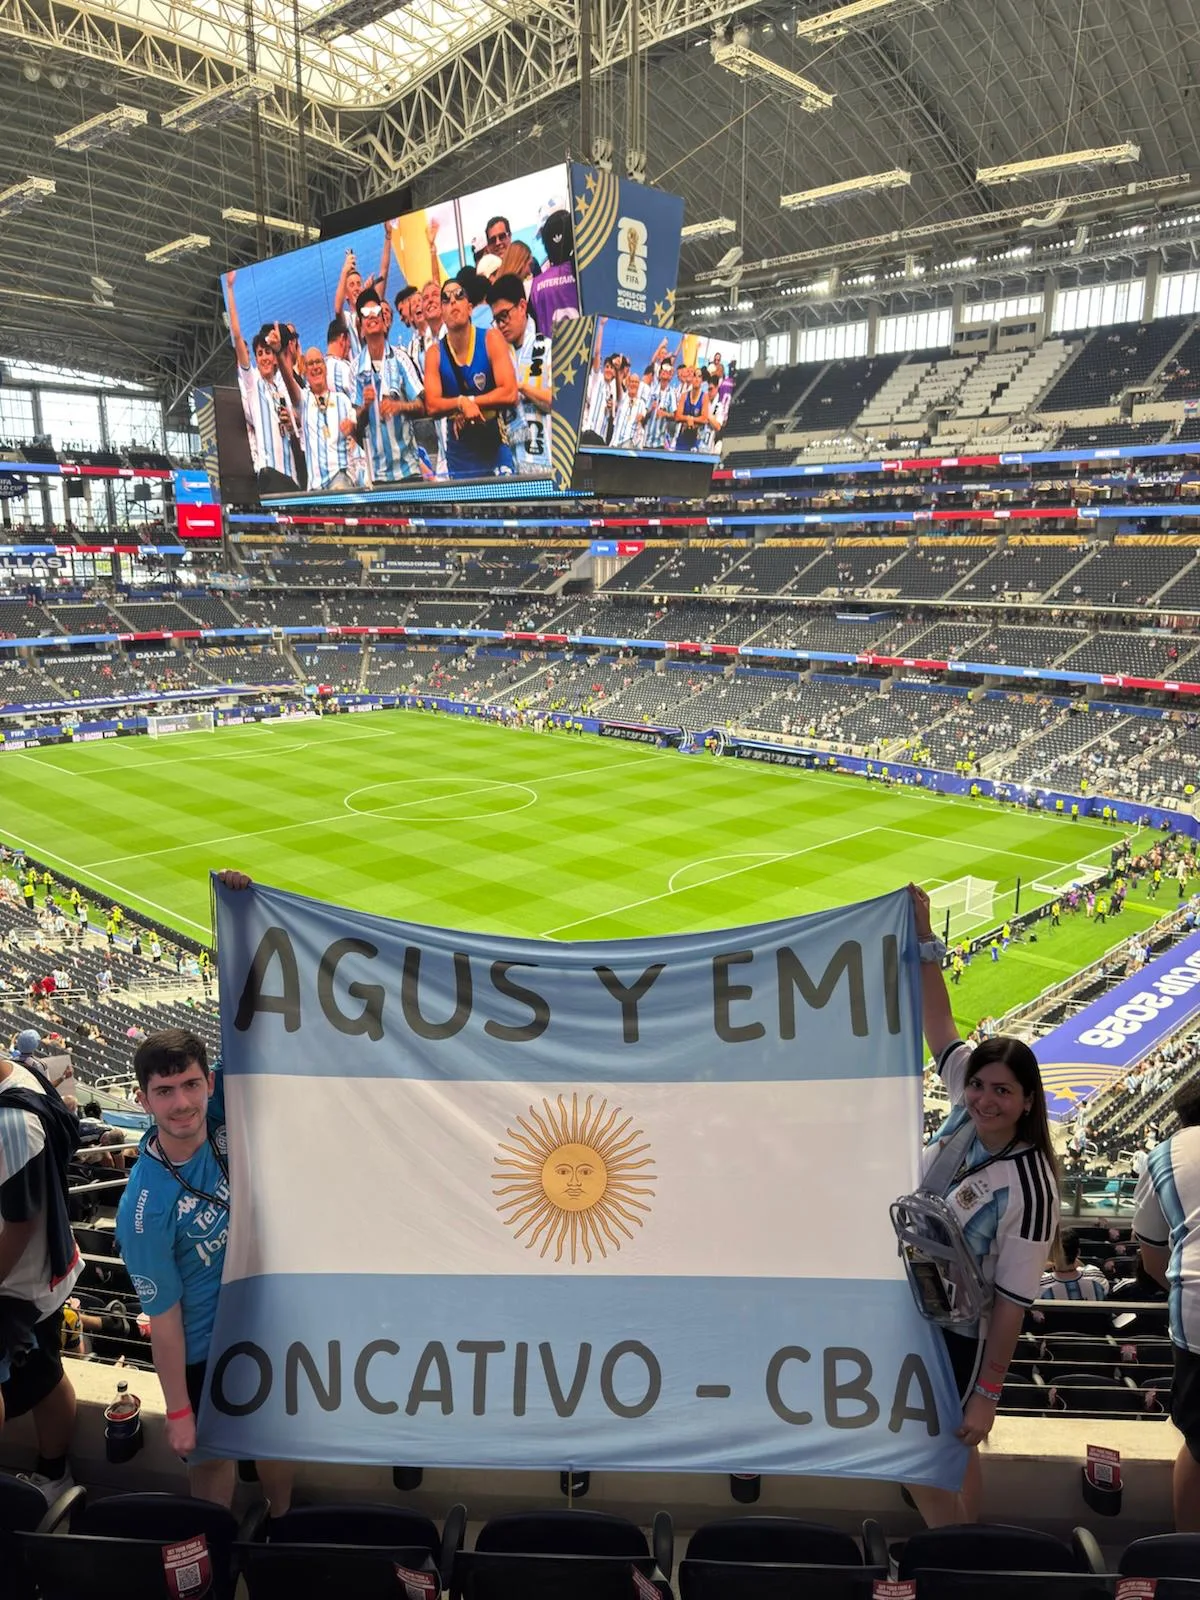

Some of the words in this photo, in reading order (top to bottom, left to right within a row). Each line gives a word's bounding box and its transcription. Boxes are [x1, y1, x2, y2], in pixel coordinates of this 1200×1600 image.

[625, 274, 639, 285] FIFA
[616, 288, 635, 299] WORLD
[635, 293, 647, 301] CUP
[616, 296, 647, 313] 2026
[0, 557, 62, 569] LLAS
[58, 656, 79, 664] WORLD
[80, 655, 91, 663] CUP
[135, 650, 177, 660] DALLAS
[233, 926, 550, 1042] AGUS
[592, 963, 668, 1043] Y
[712, 934, 901, 1043] EMI
[1078, 991, 1175, 1049] 2026
[135, 1189, 149, 1234] URQUIZA
[210, 1338, 662, 1418] ONCATIVO
[766, 1345, 940, 1437] CBA
